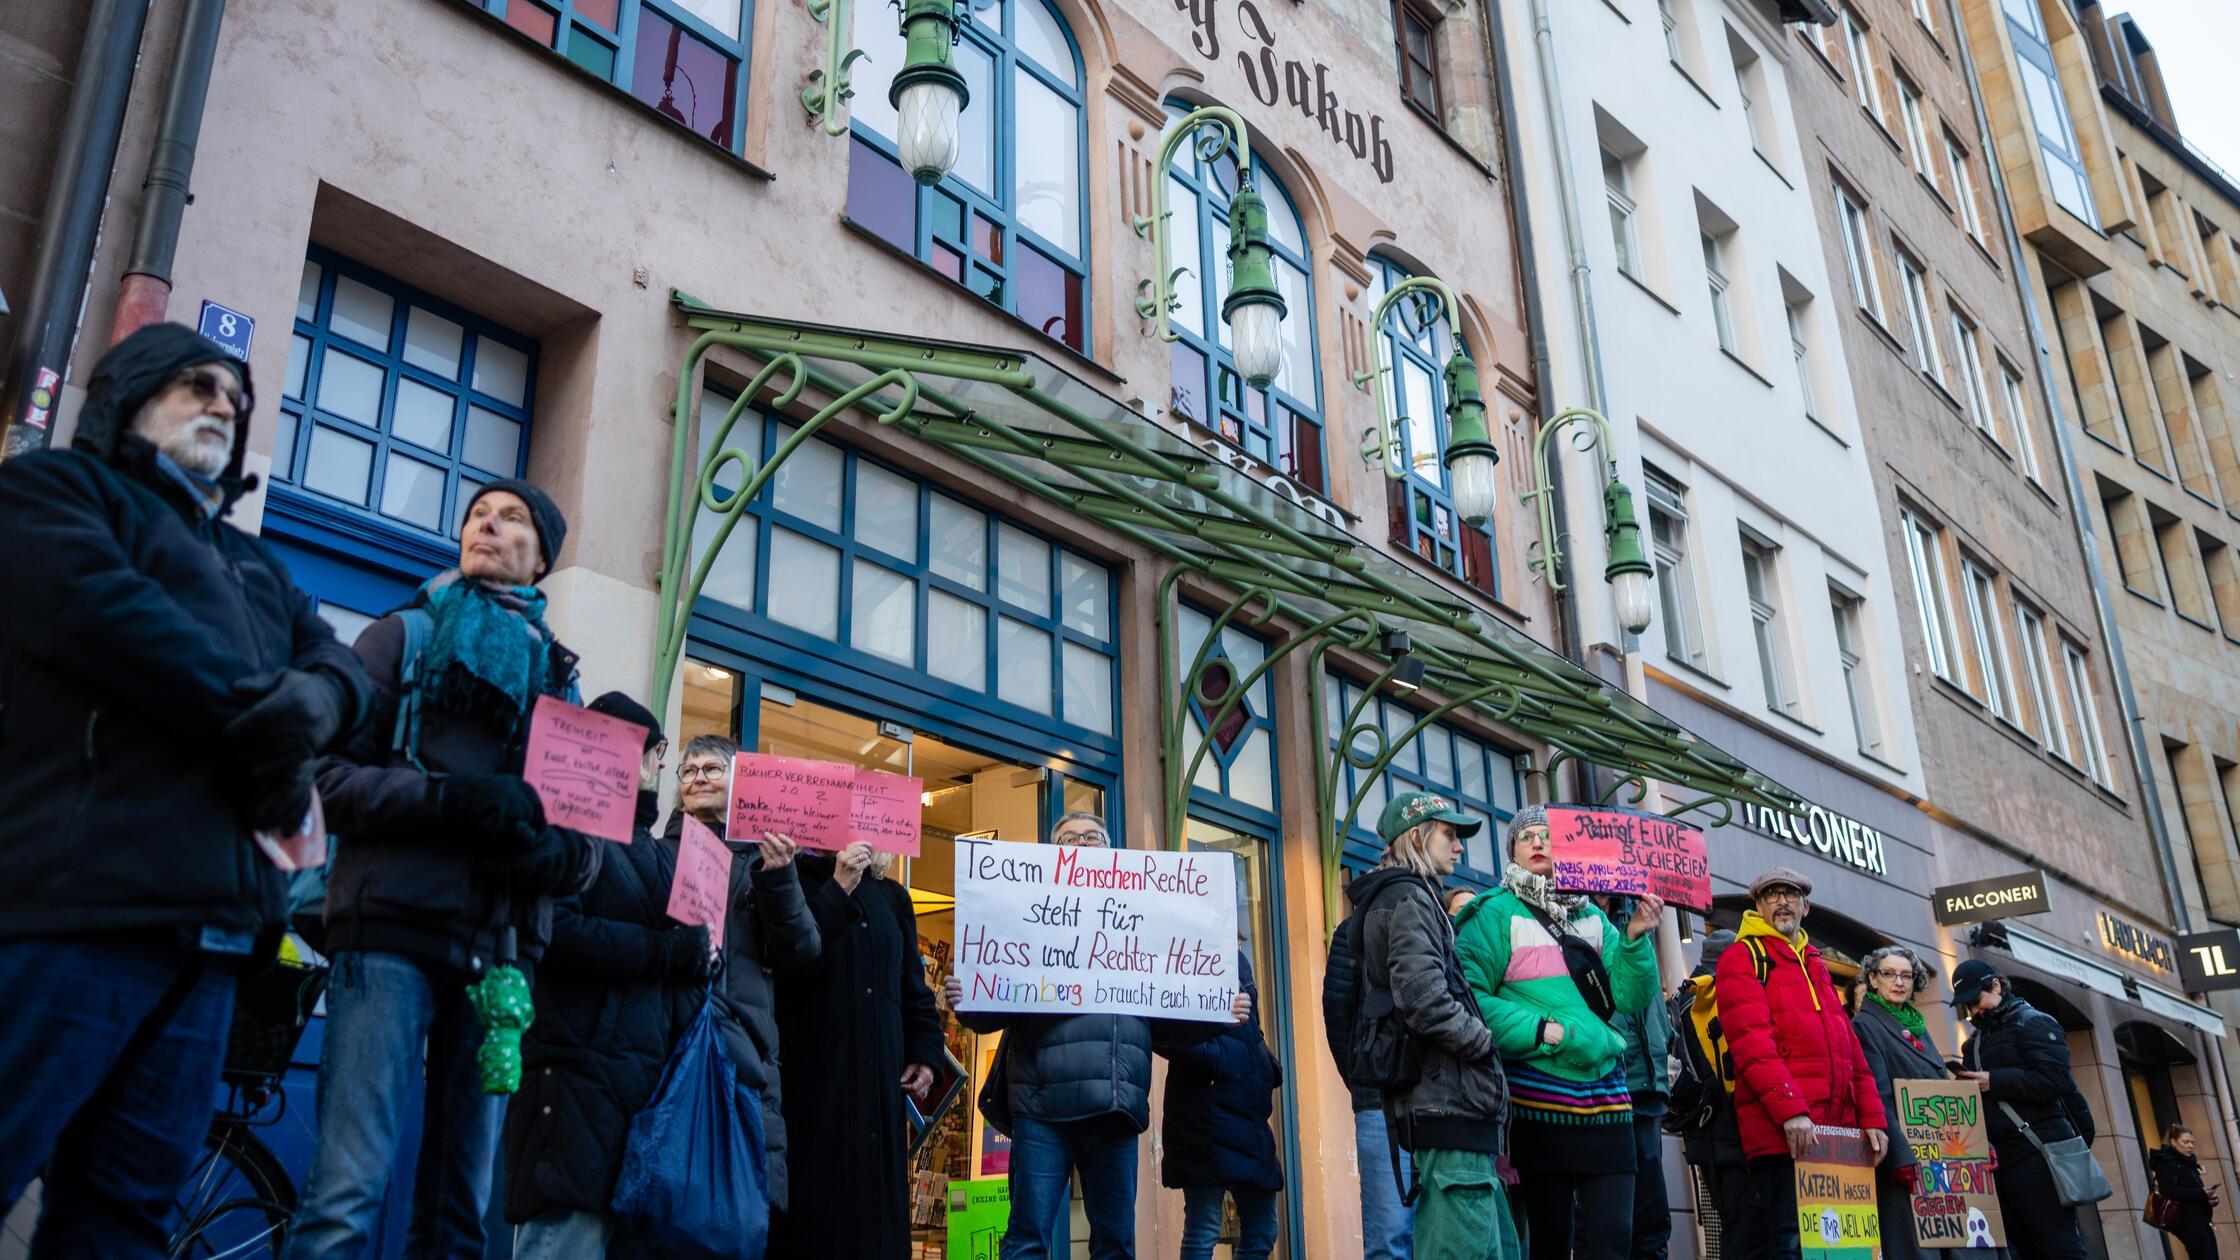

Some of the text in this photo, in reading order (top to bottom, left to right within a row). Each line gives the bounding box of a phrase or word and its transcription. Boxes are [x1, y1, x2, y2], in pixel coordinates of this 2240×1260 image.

[218, 313, 237, 338] 8
[736, 796, 773, 814] Danke,
[1639, 818, 1690, 854] EURE
[956, 839, 1209, 897] Team MenschenRechte
[1587, 864, 1613, 875] APRIL
[1615, 865, 1638, 877] 1933
[1022, 895, 1144, 932] steht für
[1945, 884, 2039, 914] FALCONERI
[961, 924, 1031, 967] Hass
[1042, 935, 1080, 969] und
[1087, 930, 1159, 974] Rechter
[1165, 936, 1226, 976] Hetze
[972, 971, 1235, 1012] Nürnberg braucht euch nicht
[1901, 1087, 1977, 1129] LESEN
[1798, 1167, 1871, 1201] KATZEN HASSEN
[1913, 1196, 1966, 1217] GEGEN
[1802, 1212, 1819, 1233] DIE
[1841, 1213, 1861, 1239] WEIL
[1861, 1214, 1880, 1239] WIR
[1916, 1213, 1965, 1241] KLEIN
